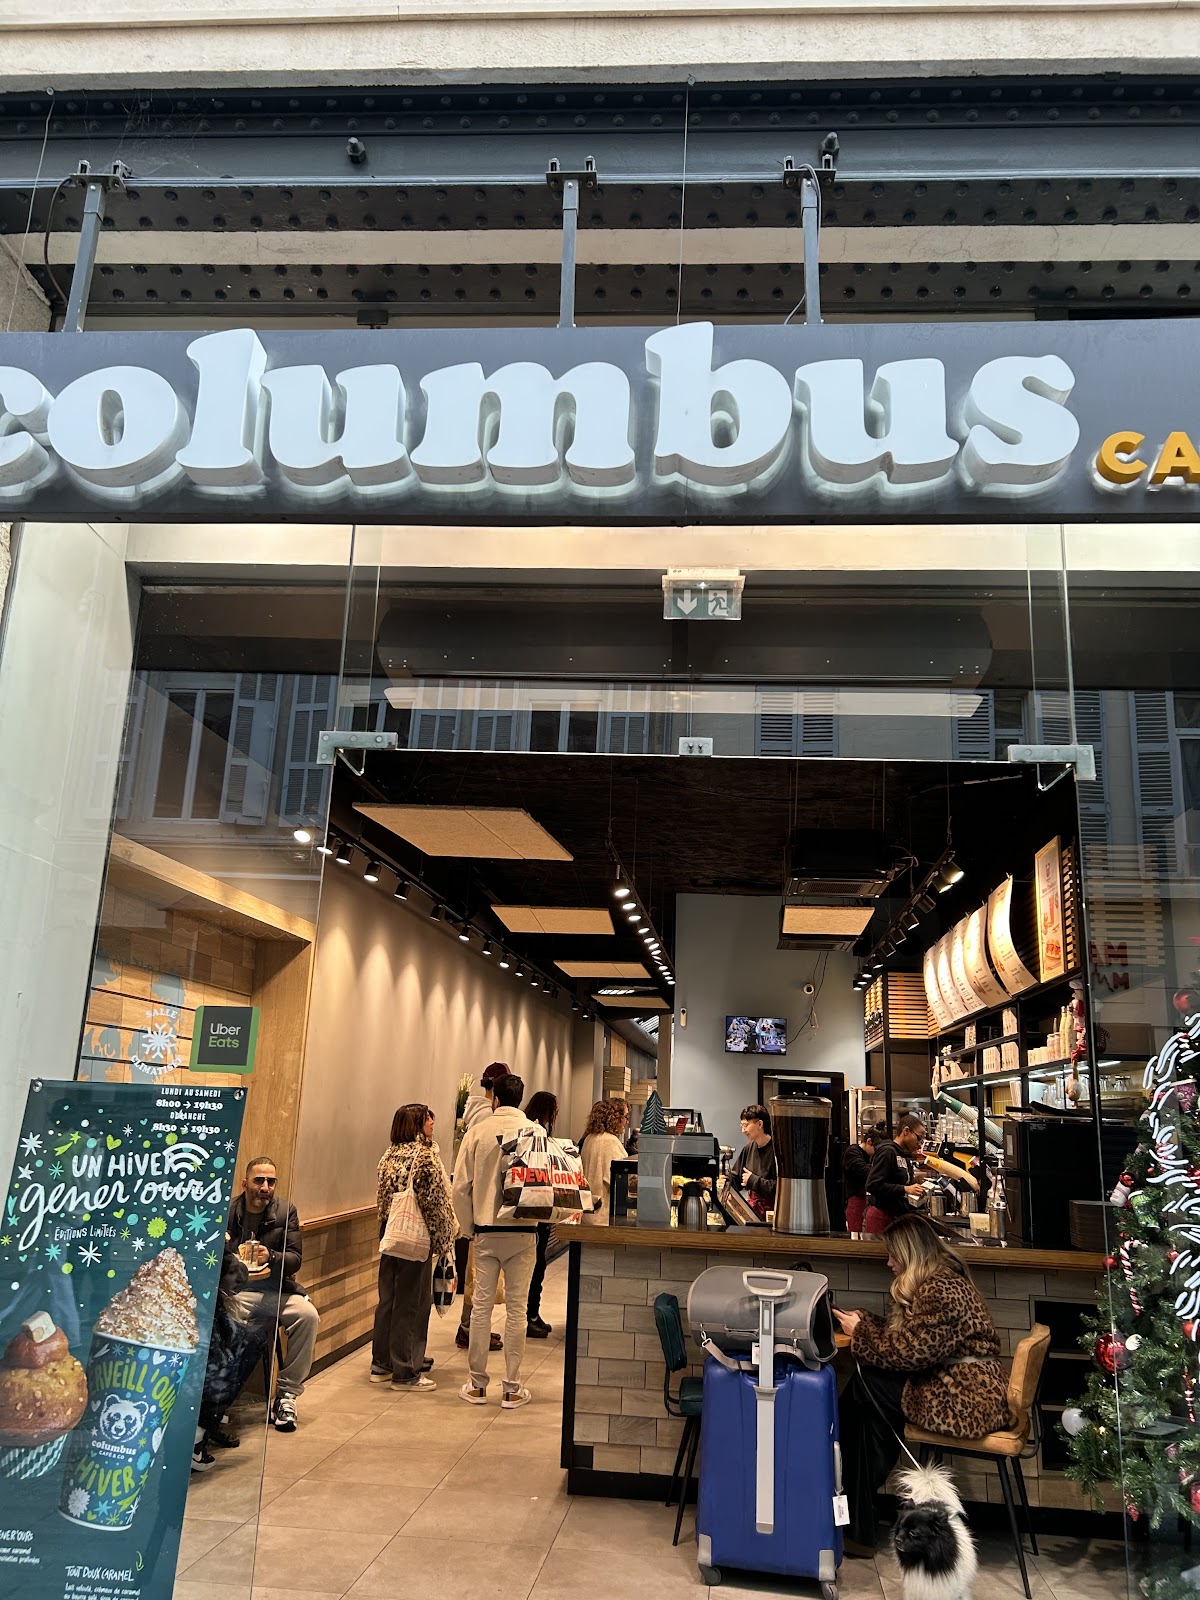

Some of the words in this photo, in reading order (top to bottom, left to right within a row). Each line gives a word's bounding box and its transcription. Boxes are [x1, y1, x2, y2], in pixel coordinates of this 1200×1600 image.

[145, 1008, 179, 1019] SALLE
[210, 1022, 241, 1036] Uber
[208, 1036, 240, 1049] Eats
[161, 1087, 182, 1096] LUNDI
[184, 1088, 194, 1096] AU
[194, 1089, 221, 1098] SAMEDI
[155, 1099, 181, 1109] 8h00
[193, 1101, 223, 1111] 19h30
[152, 1123, 177, 1132] 8h30
[190, 1124, 220, 1135] 19h30
[72, 1154, 101, 1178] UN
[91, 1439, 137, 1455] columbus
[101, 1568, 135, 1582] CARAMEL
